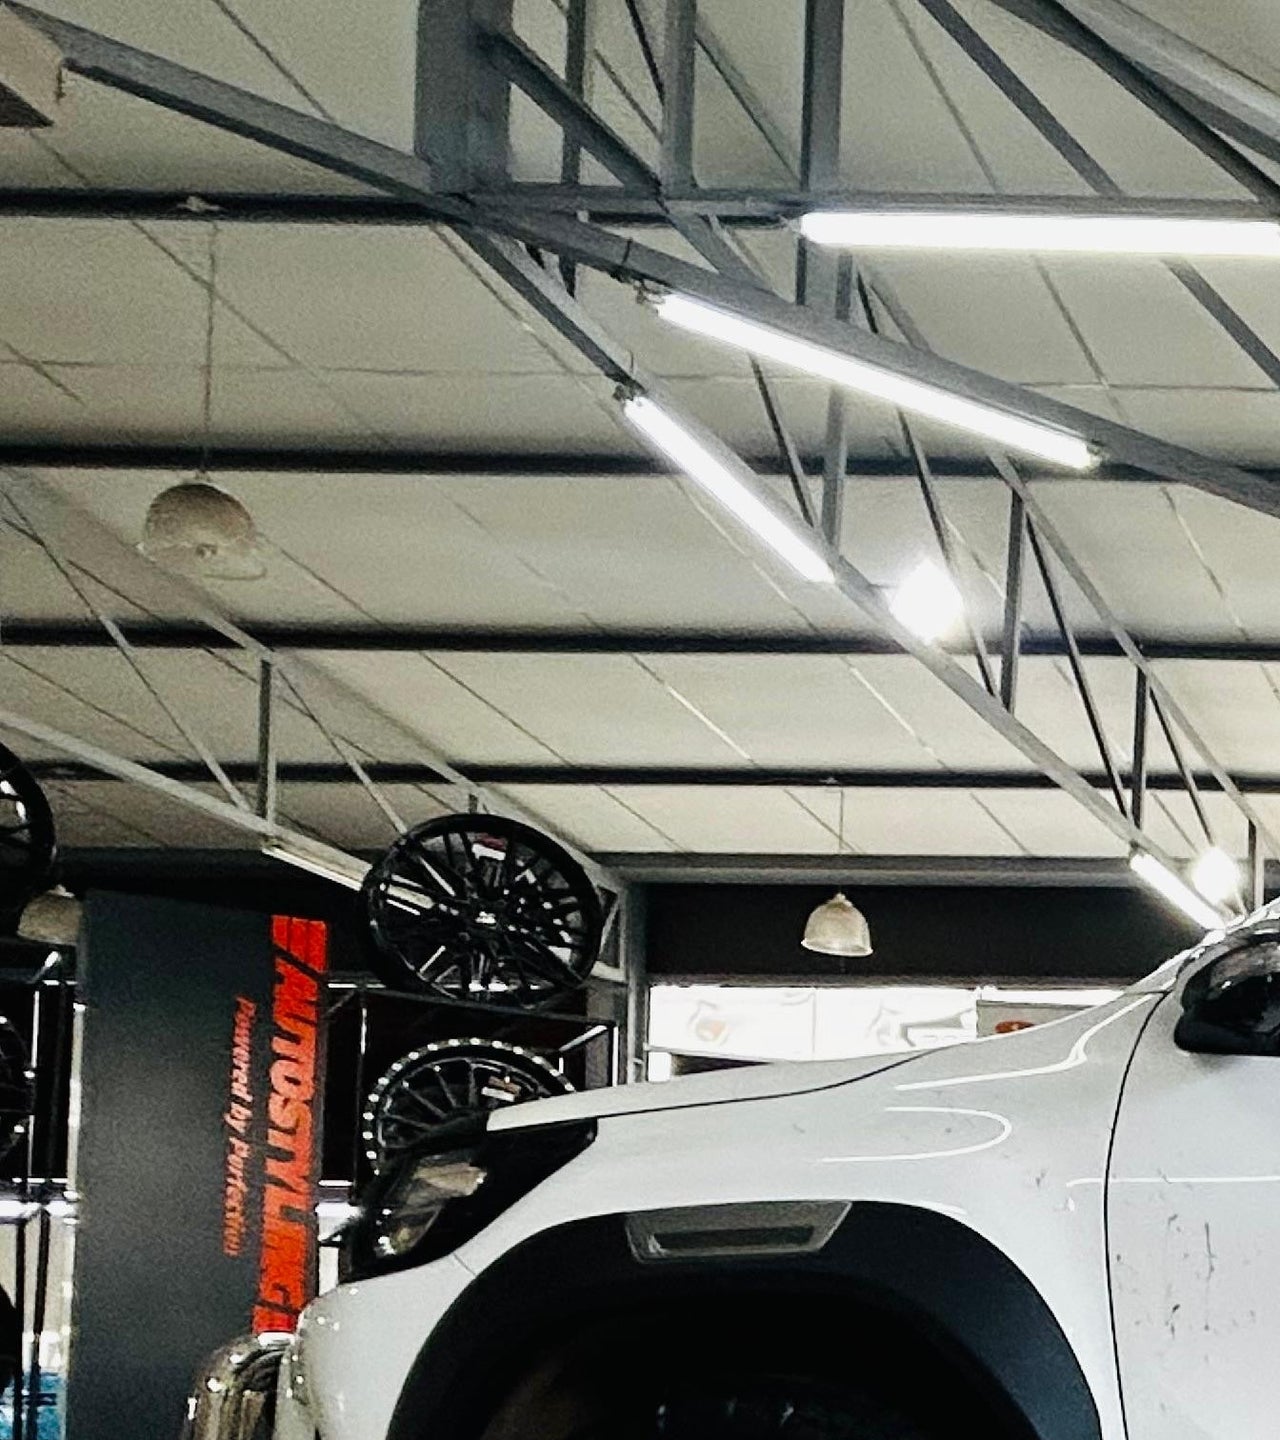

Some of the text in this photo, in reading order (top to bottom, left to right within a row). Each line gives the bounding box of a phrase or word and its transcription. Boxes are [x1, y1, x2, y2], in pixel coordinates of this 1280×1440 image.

[230, 995, 257, 1102] Powered
[224, 1102, 253, 1135] by
[255, 957, 320, 1313] AUTOSTYLING
